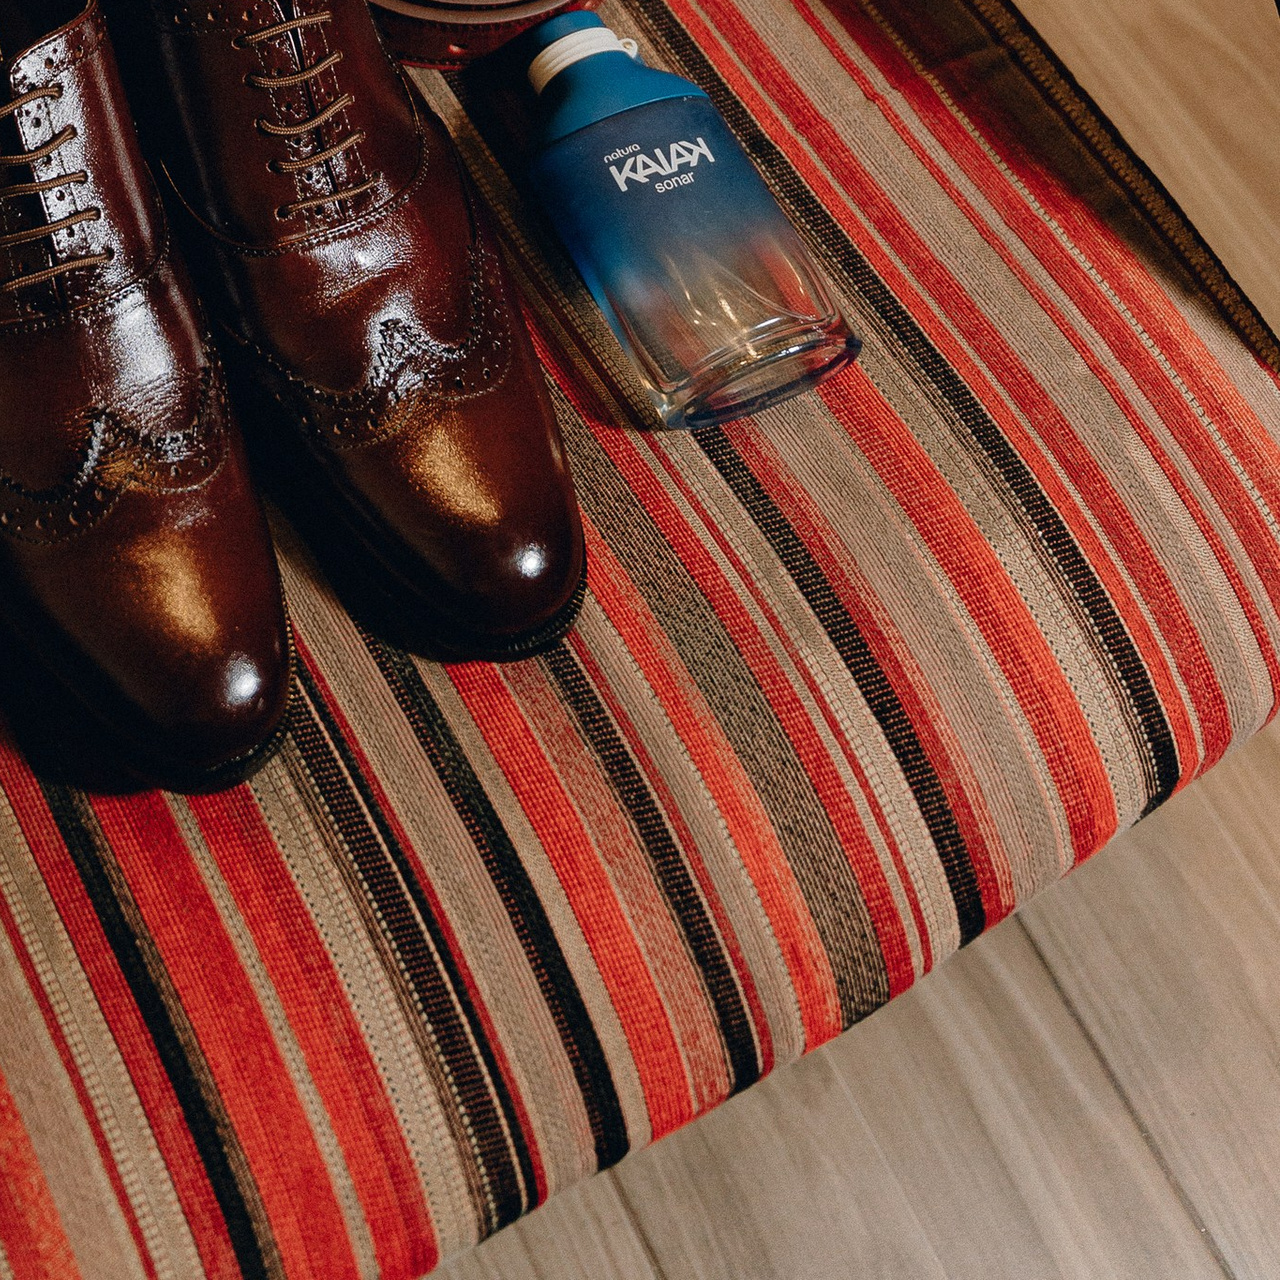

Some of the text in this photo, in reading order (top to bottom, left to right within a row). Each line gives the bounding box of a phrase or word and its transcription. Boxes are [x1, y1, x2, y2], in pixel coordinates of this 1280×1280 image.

[603, 143, 641, 163] natura
[609, 137, 715, 192] KAIAK
[655, 171, 695, 193] sonar
